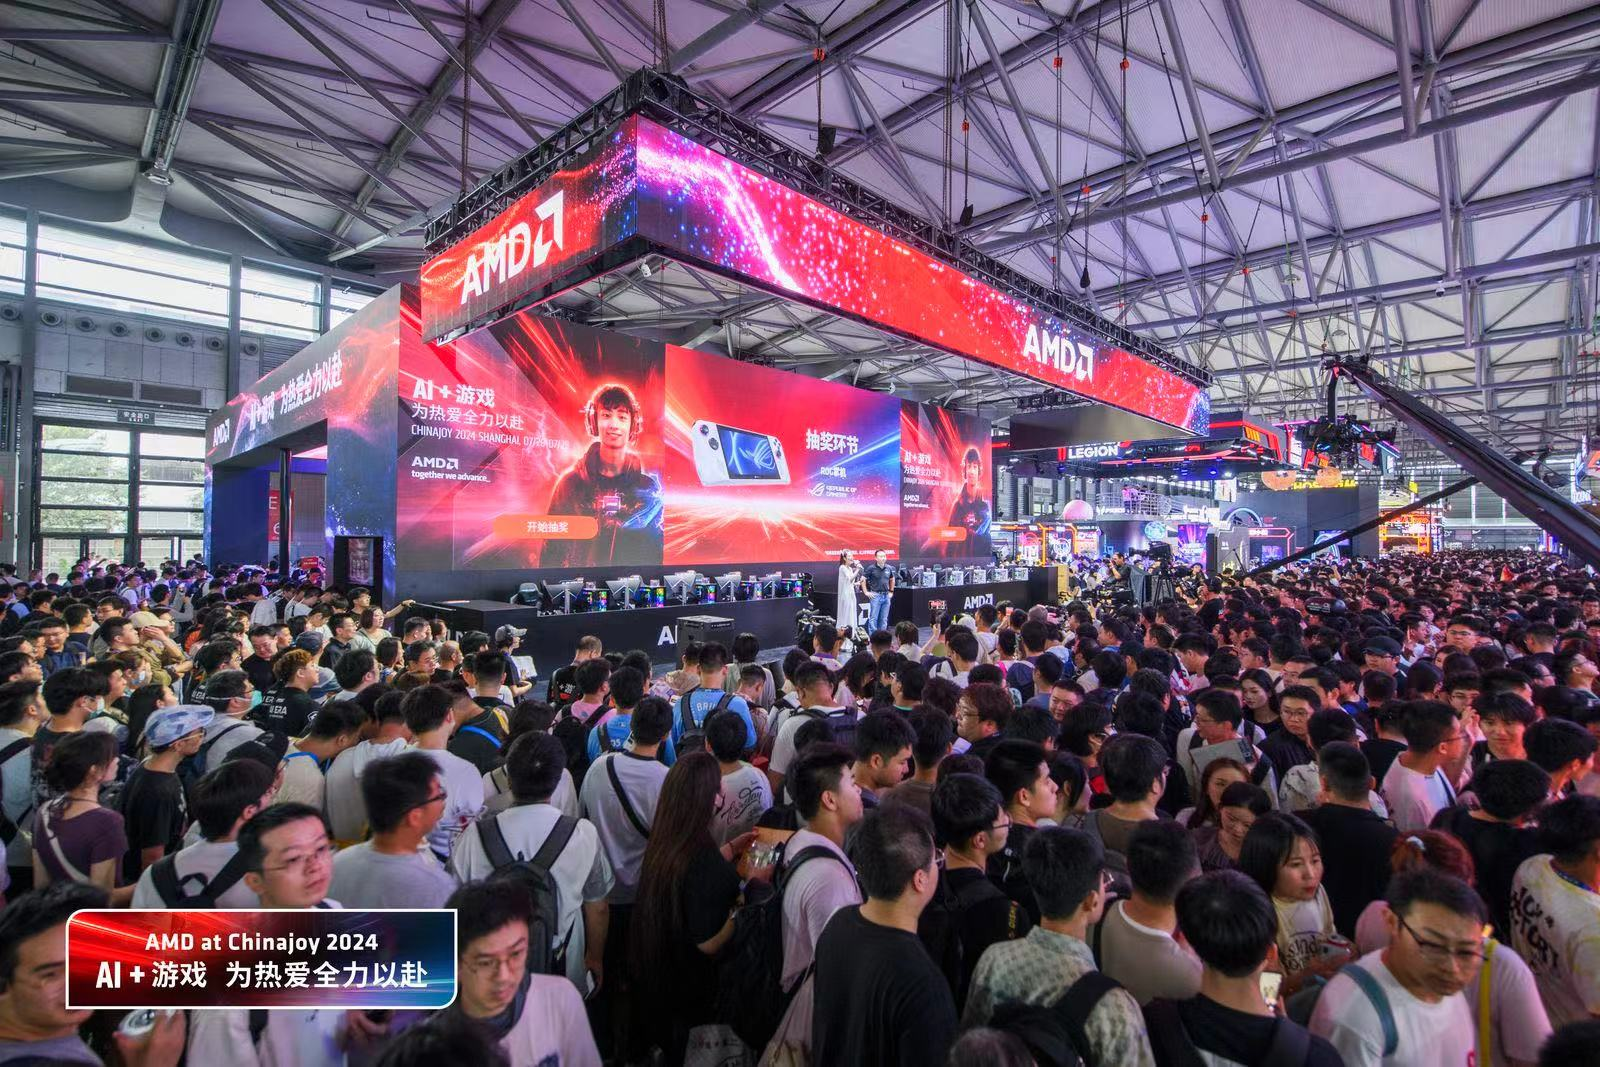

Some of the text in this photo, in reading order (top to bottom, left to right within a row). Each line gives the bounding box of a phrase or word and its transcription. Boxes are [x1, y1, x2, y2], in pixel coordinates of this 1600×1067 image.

[461, 221, 531, 304] AMD
[1023, 324, 1076, 373] AMD
[412, 379, 434, 400] AI
[456, 383, 496, 408] 游戏
[411, 402, 525, 431] 为热爱全力以赴
[411, 424, 453, 440] CHINAJOY
[455, 430, 476, 441] 2024
[806, 428, 859, 455] 抽奖环节
[411, 456, 447, 469] AMD
[1068, 445, 1118, 459] LEGION
[411, 470, 445, 480] together
